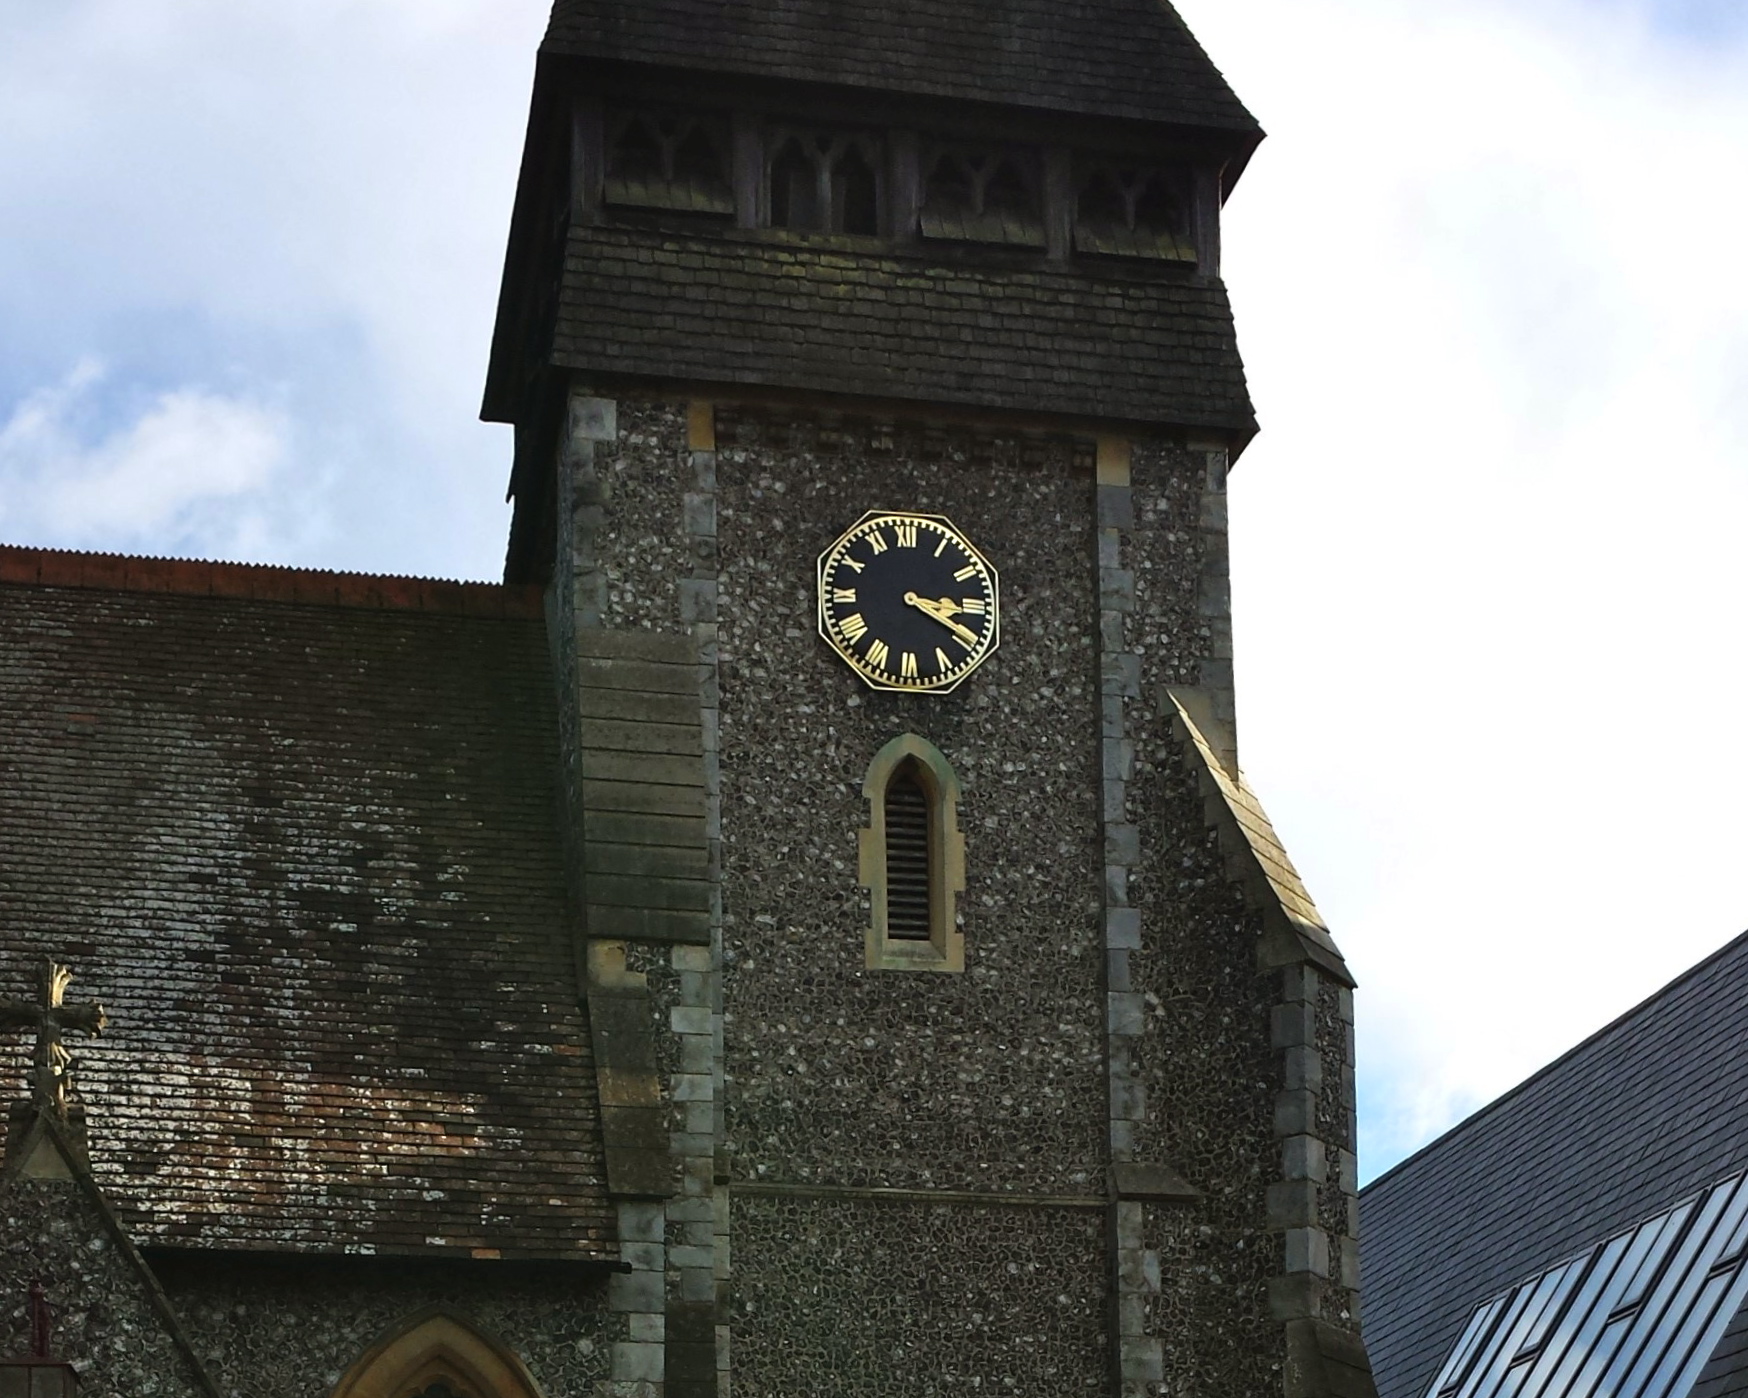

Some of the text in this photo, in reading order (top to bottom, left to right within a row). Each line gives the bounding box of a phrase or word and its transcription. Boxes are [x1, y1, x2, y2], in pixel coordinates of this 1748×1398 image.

[865, 530, 888, 555] XI
[894, 525, 917, 548] XII
[934, 538, 948, 558] I
[841, 554, 865, 574] X
[953, 565, 977, 582] II
[833, 588, 856, 603] IX
[962, 598, 985, 615] III
[838, 612, 868, 645] VIII
[952, 624, 979, 651] III
[865, 638, 889, 670] VII
[901, 652, 918, 678] VI
[935, 646, 953, 673] V
